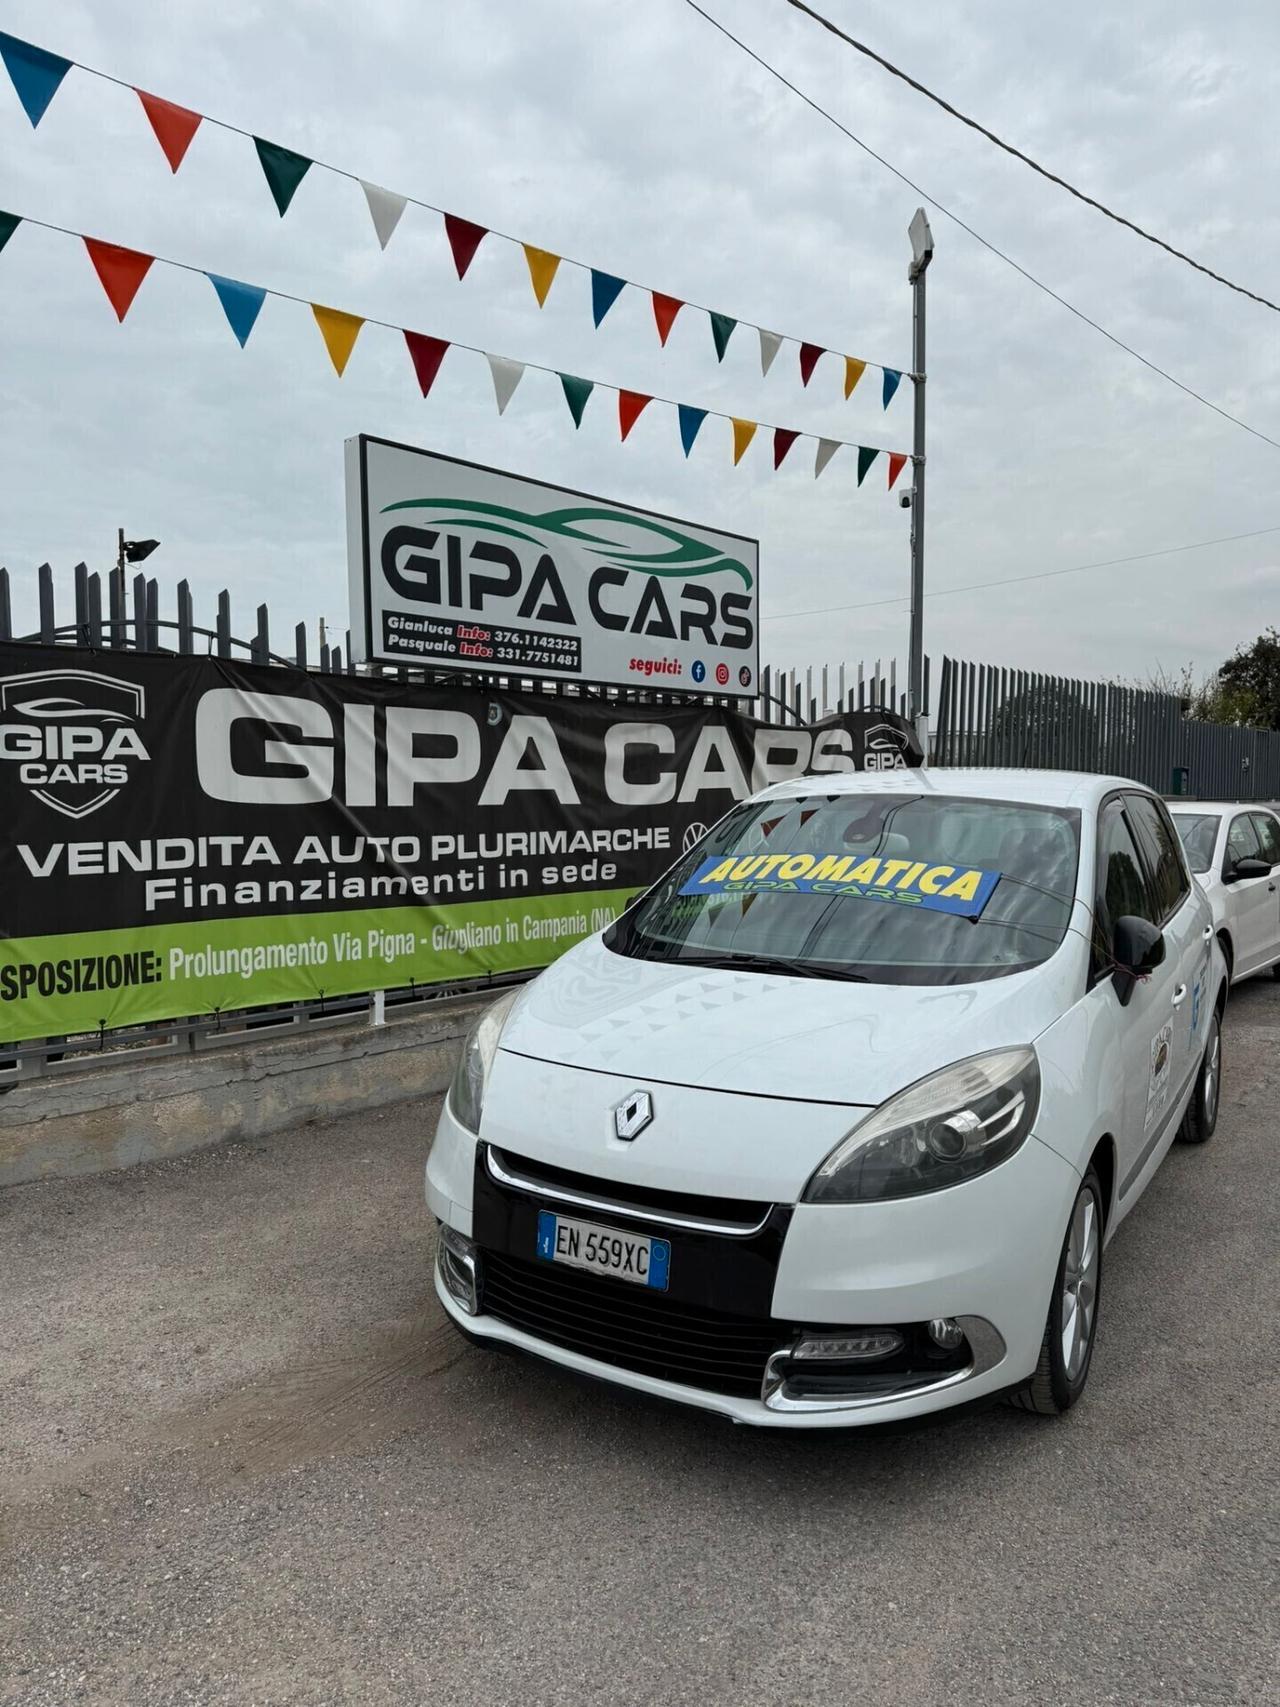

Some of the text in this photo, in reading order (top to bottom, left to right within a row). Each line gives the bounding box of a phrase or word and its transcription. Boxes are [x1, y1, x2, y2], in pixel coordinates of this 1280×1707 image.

[381, 525, 753, 649] GIPA CARS
[388, 616, 577, 651] Gianluca Info: 376.1142322
[388, 634, 578, 666] Pasquale Info: 331.7751481
[629, 657, 682, 676] seguici:
[0, 724, 151, 761] GIPA
[196, 687, 856, 806] GIPA CARS
[864, 752, 908, 770] GIPA
[20, 763, 128, 784] CARS
[17, 827, 671, 878] VENDITA AUTO PLURIMARCHE
[145, 859, 617, 911] Finanziamenti in sede
[698, 853, 983, 901] AUTOMATICA
[723, 880, 925, 905] GIPA CARS
[169, 936, 328, 980] Prolungamento
[333, 931, 362, 962] Via
[367, 929, 415, 963] Pigna
[432, 921, 501, 954] Giugliano
[506, 917, 519, 942] in
[523, 909, 587, 942] Campania
[556, 1225, 649, 1276] EN 559XC
